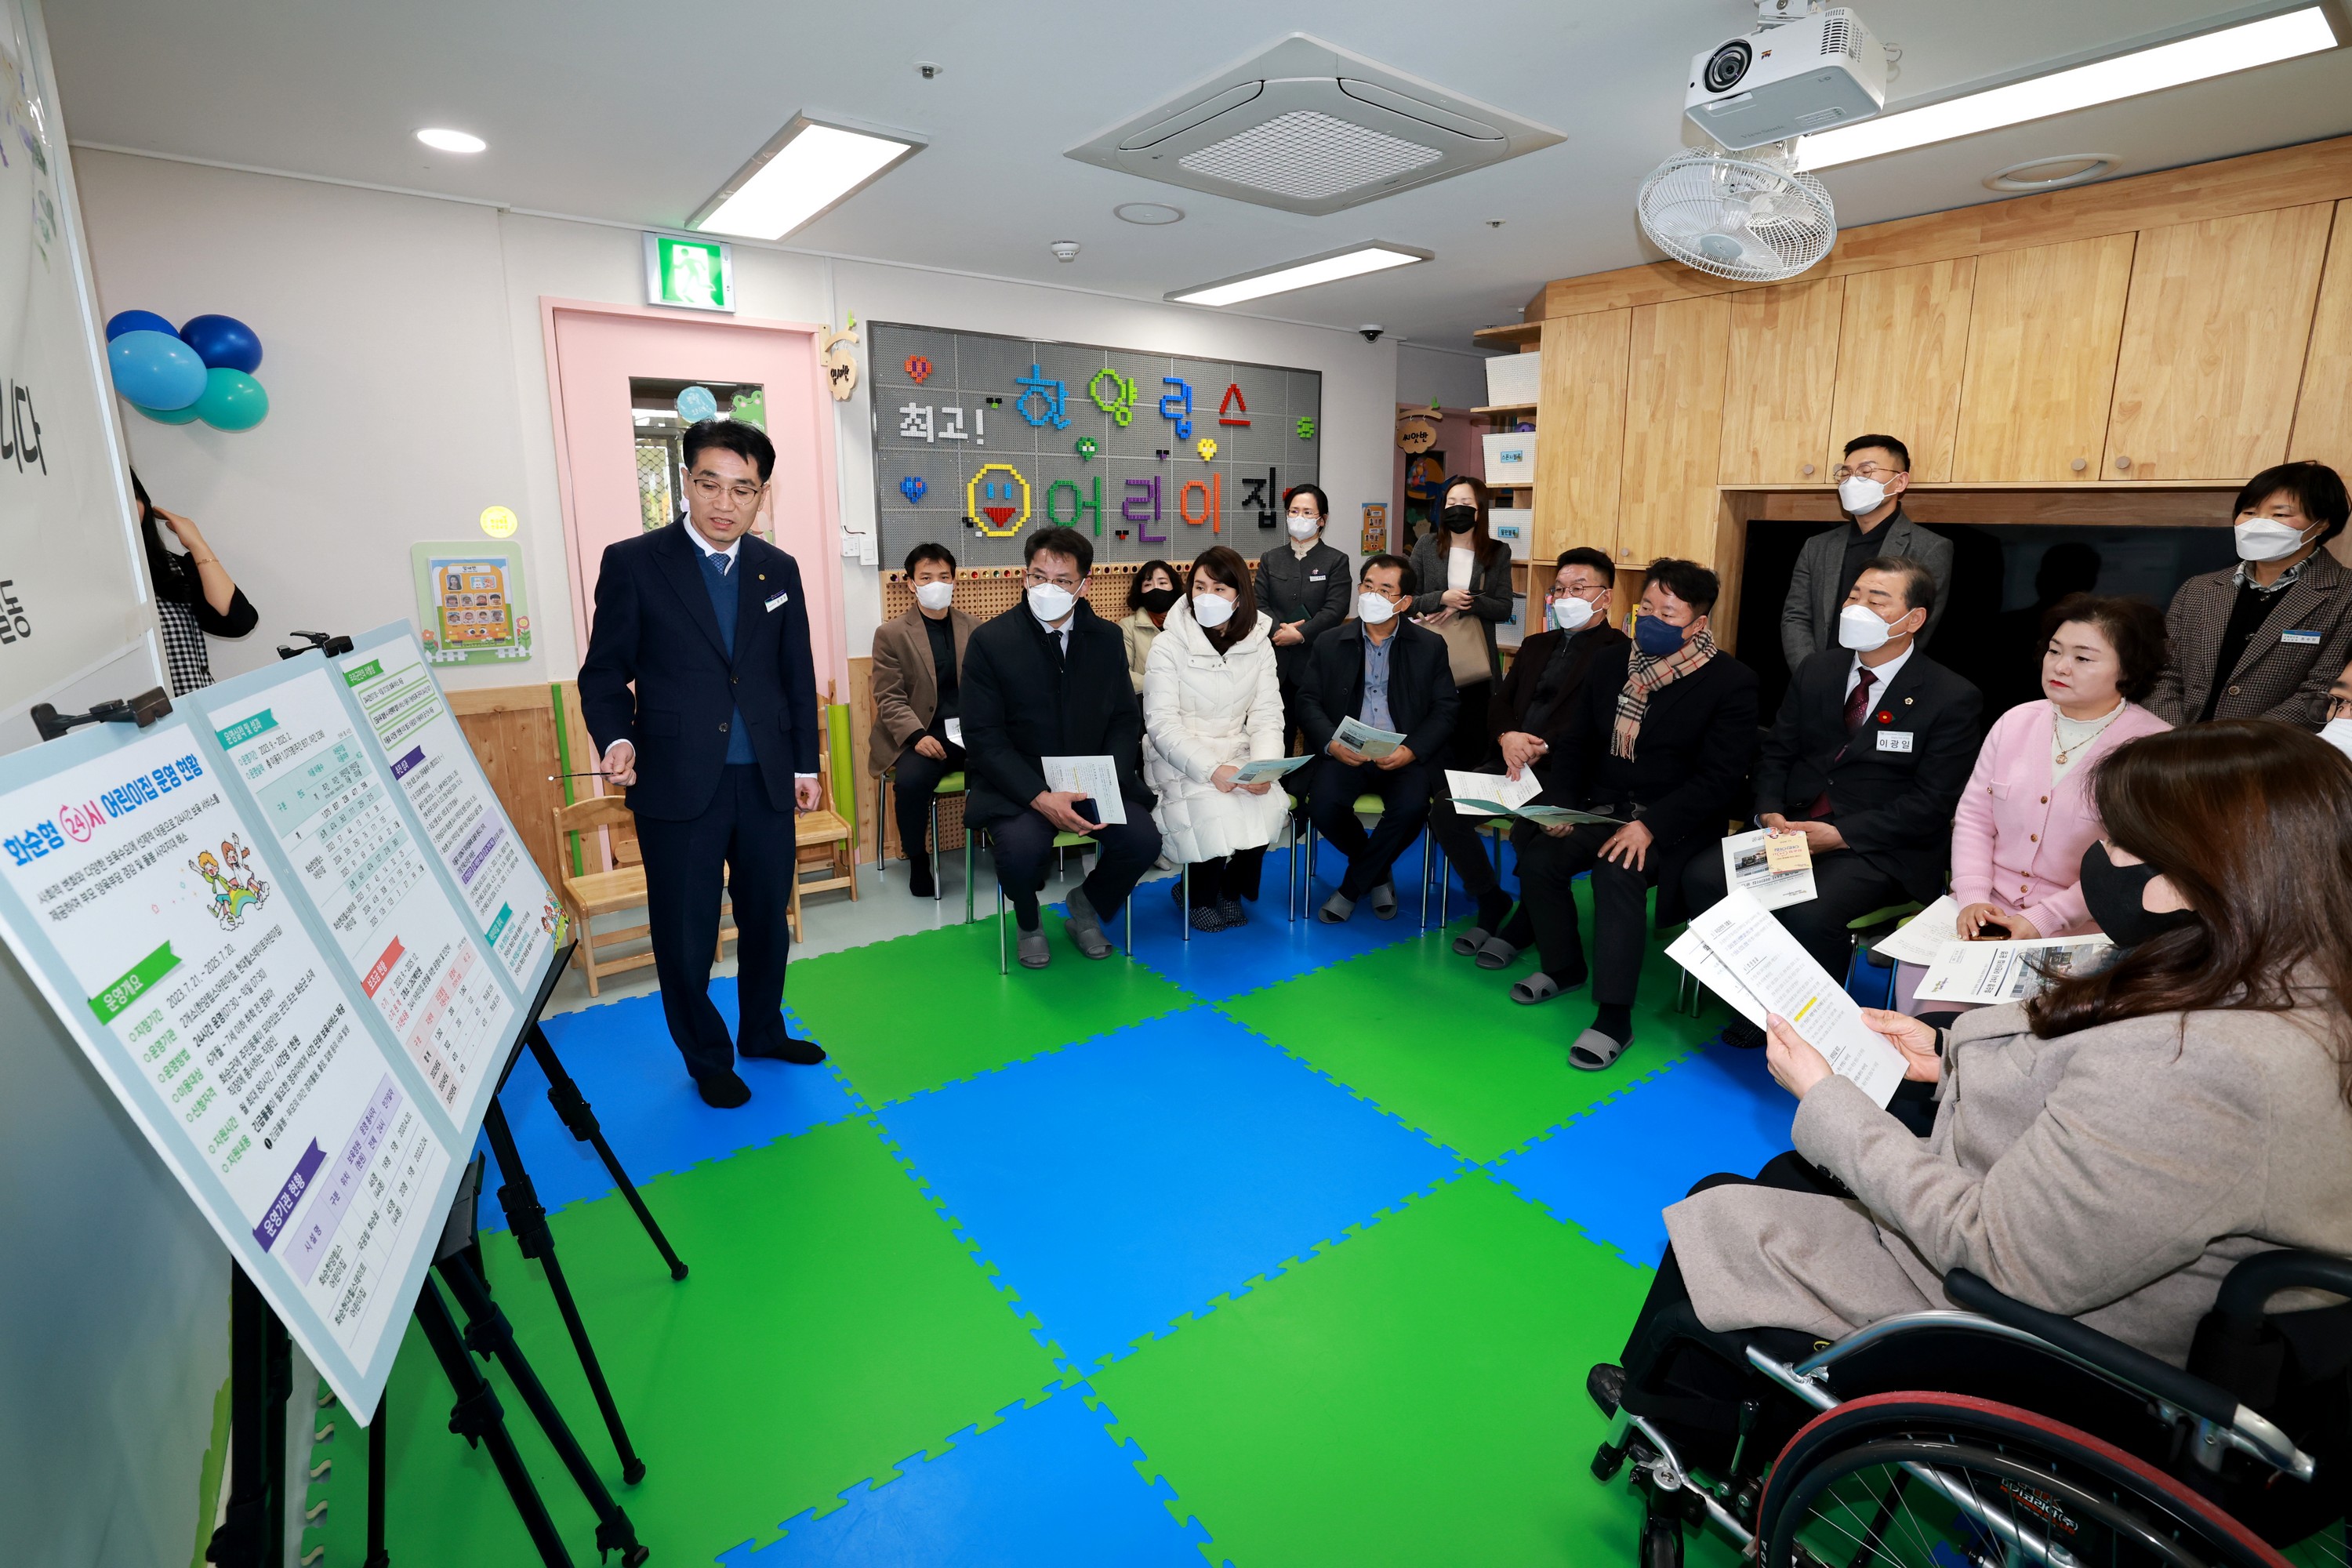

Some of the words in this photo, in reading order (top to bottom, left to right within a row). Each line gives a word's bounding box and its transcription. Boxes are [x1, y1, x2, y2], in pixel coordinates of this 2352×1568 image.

[1740, 125, 1784, 140] ViewSonic
[899, 402, 984, 445] 최고!
[1403, 431, 1428, 443] 씨앗반
[1048, 467, 1276, 542] 어린이집
[3, 819, 65, 866] 화순형
[100, 775, 158, 818] 어린이집
[151, 764, 182, 793] 운영
[175, 753, 203, 782] 현황
[61, 871, 85, 891] 변화와
[82, 858, 107, 877] 다양한
[105, 840, 138, 866] 보육수요에
[136, 830, 156, 848] 선제적
[152, 818, 177, 837] 대응으로
[173, 808, 194, 826] 24시간
[190, 802, 203, 816] 보육
[200, 792, 220, 809] 서비스를
[48, 897, 81, 920] 제공하여
[79, 887, 97, 902] 부모
[94, 871, 124, 895] 양육부담
[120, 863, 137, 879] 경감
[133, 858, 145, 871] 및
[140, 851, 157, 866] 돌봄
[154, 837, 178, 857] 사각지대
[174, 832, 189, 844] 해소
[103, 974, 143, 1011] 운영개요
[133, 1007, 164, 1036] 지정기간
[165, 988, 187, 1009] 2023.
[203, 955, 223, 975] 2025.
[148, 1028, 177, 1059] 운영기관
[179, 969, 239, 1028] 2개소(한양립스어린이집,
[234, 924, 282, 974] 현대힐스테이트어린이집)
[162, 1047, 191, 1079] 운영방법
[192, 1022, 215, 1047] 24시간
[210, 996, 239, 1029] 운영(07:30
[239, 982, 254, 996] 익일
[249, 967, 267, 988] 07:30)
[176, 1067, 204, 1097] 이용대상
[205, 1044, 224, 1066] 6개월
[223, 1029, 238, 1044] 7세
[233, 1018, 248, 1034] 이하
[243, 1007, 257, 1024] 취학
[252, 1000, 263, 1014] 전
[258, 987, 275, 1008] 영유아
[191, 1086, 217, 1118] 신청자격
[218, 1055, 242, 1084] 화순군에
[238, 1029, 265, 1059] 주민등록이
[260, 1011, 281, 1034] 되어있는
[277, 999, 290, 1015] 군민
[285, 991, 298, 1005] 또는
[293, 976, 309, 995] 화순군
[305, 967, 316, 983] 소재
[227, 1073, 246, 1095] 직장에
[241, 1052, 265, 1080] 종사하는
[260, 1034, 278, 1054] 직장인
[212, 1116, 238, 1146] 지원시간
[238, 1102, 249, 1116] 월
[245, 1088, 259, 1106] 최대
[255, 1069, 274, 1094] 80시간
[274, 1047, 290, 1069] 시간당
[286, 1034, 301, 1053] 1천원
[226, 1134, 251, 1166] 지원내용
[251, 1099, 275, 1133] 긴급돌봄이
[273, 1080, 291, 1102] 필요한
[286, 1054, 309, 1085] 영유아에게
[305, 1043, 317, 1058] 시간
[312, 1033, 324, 1049] 단위
[320, 1013, 339, 1039] 보육서비스
[334, 1002, 346, 1016] 제공
[268, 1116, 288, 1142] 긴급돌봄
[285, 1098, 299, 1116] 부모의
[358, 1120, 369, 1136] 운영
[376, 1118, 386, 1134] 24시
[381, 1155, 391, 1170] 18명
[390, 1140, 398, 1153] 5명
[263, 1191, 293, 1237] 운영기관
[287, 1171, 305, 1197] 현황
[328, 1190, 340, 1206] 구분
[339, 1170, 350, 1186] 위치
[397, 1180, 408, 1197] 20명
[406, 1164, 415, 1178] 5명
[318, 1244, 343, 1286] 화순한양립스
[368, 1171, 378, 1188] 46명
[328, 1258, 347, 1288] 어린이집
[372, 1178, 385, 1200] (44명)
[334, 1261, 366, 1326] 화순현대힐스테이트
[386, 1197, 396, 1214] 45명
[349, 1287, 367, 1318] 어린이집
[390, 1205, 402, 1226] (44명)
[357, 1229, 371, 1250] 국공립
[366, 1209, 379, 1231] 화순읍
